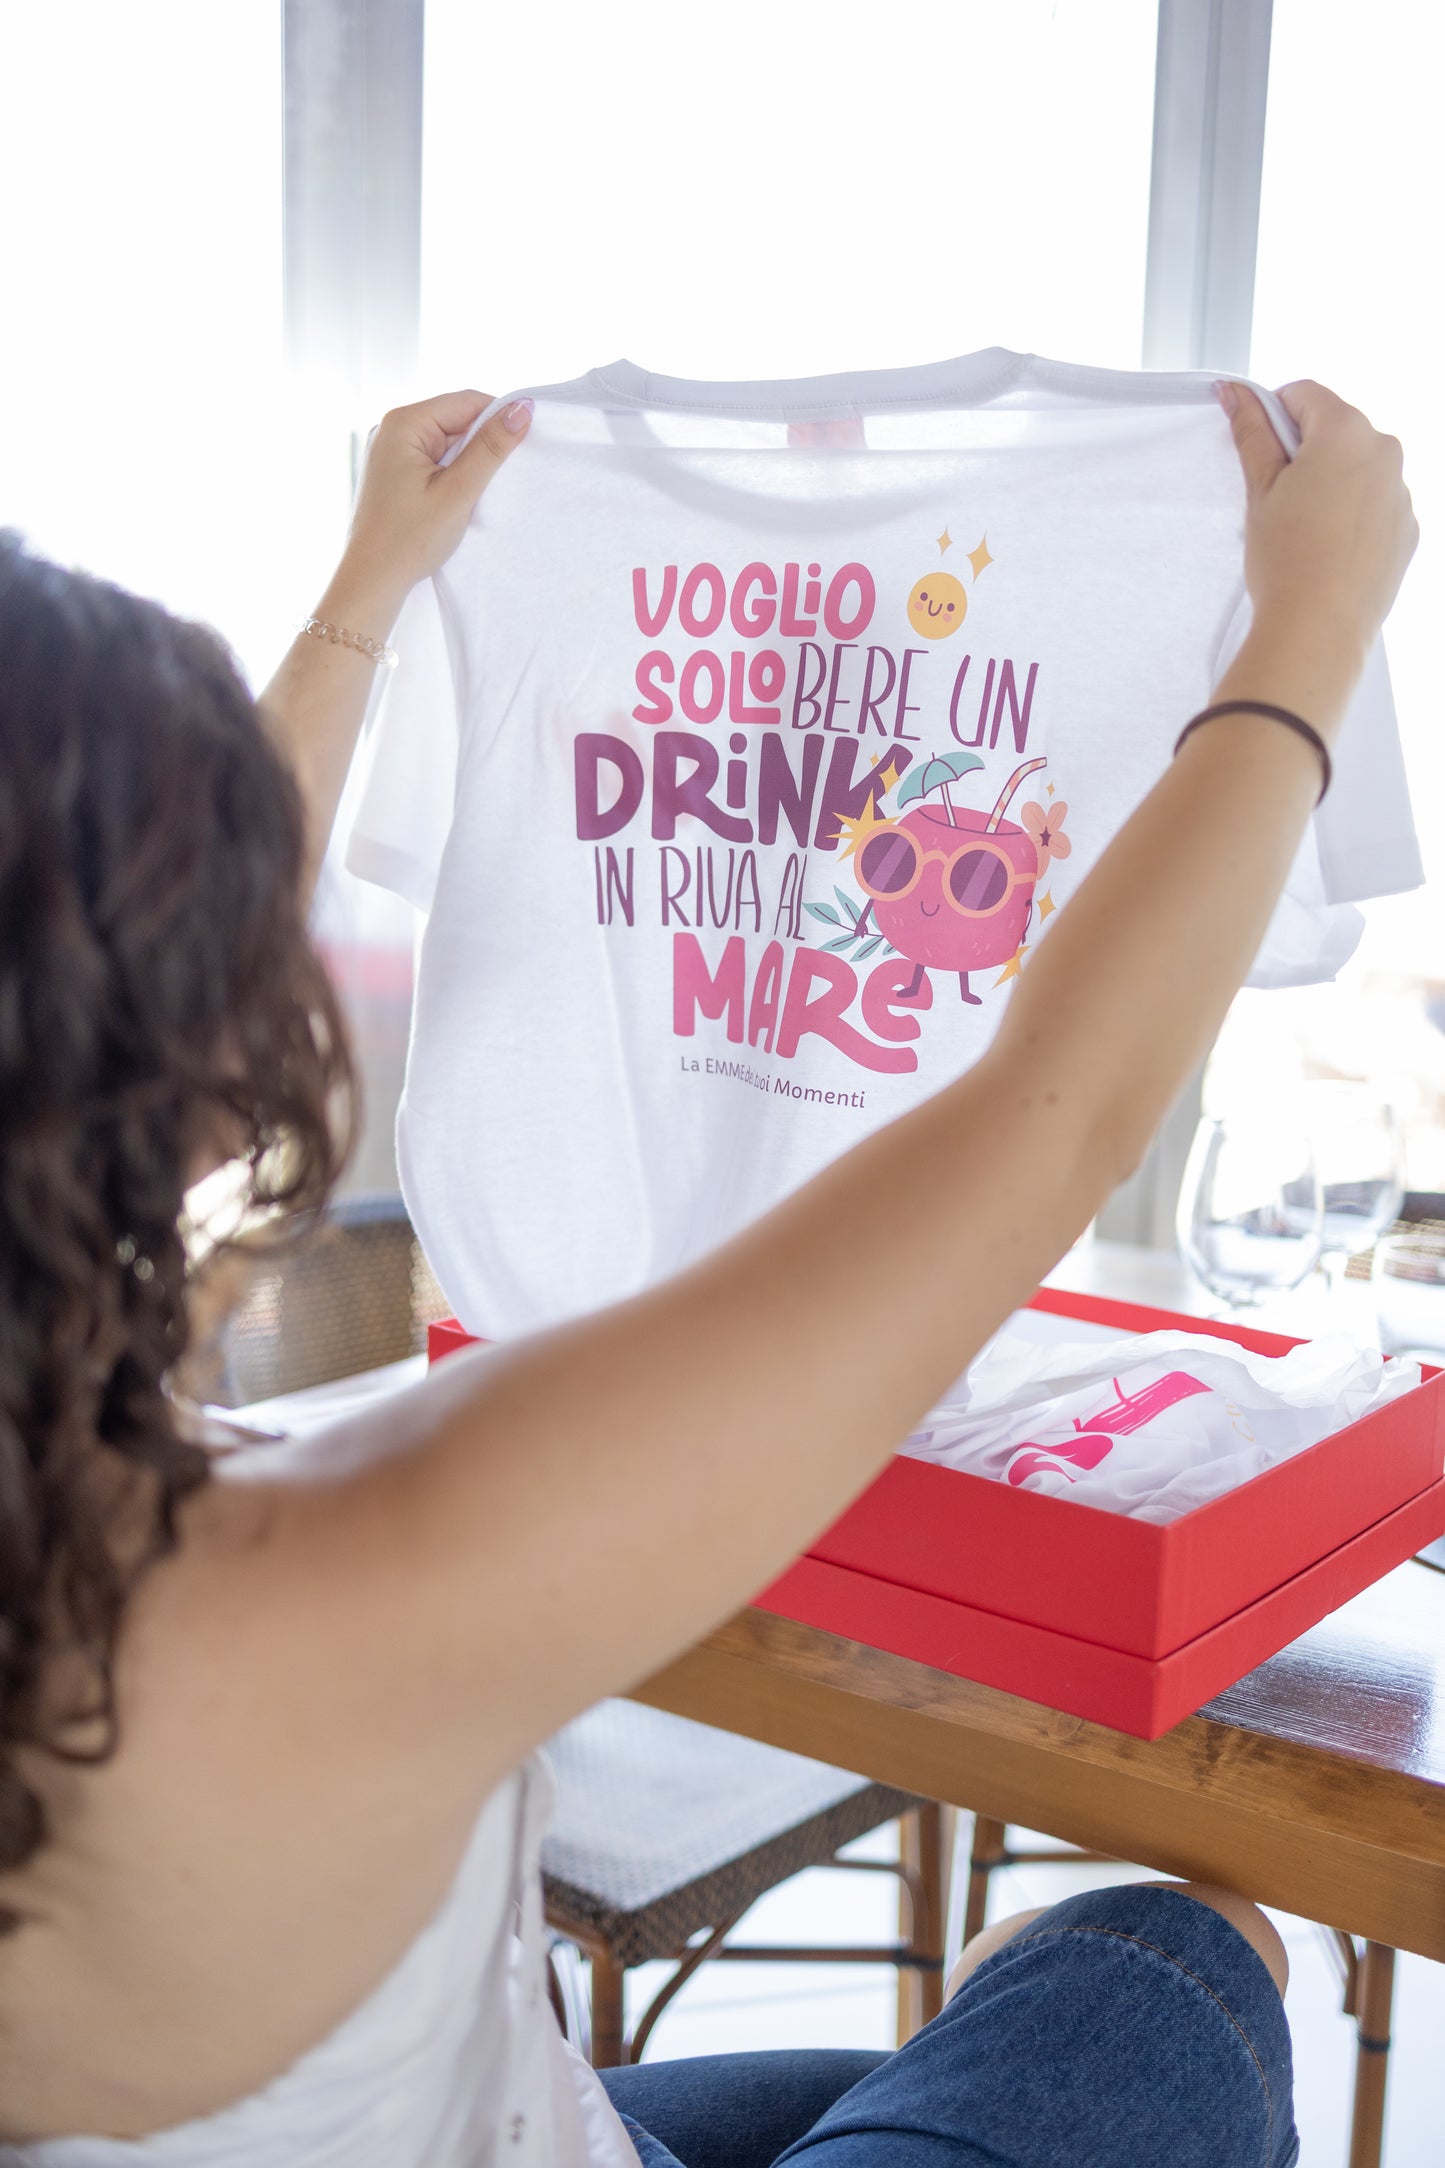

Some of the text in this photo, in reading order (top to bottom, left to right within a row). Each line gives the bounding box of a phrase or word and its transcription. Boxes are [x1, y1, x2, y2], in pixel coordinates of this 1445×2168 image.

[632, 642, 1040, 754] SOLO BERE UN
[595, 846, 635, 927] IN
[660, 846, 762, 933] RIVA
[681, 1056, 699, 1072] La
[706, 1058, 745, 1081] EMME
[774, 1078, 866, 1108] Momenti
